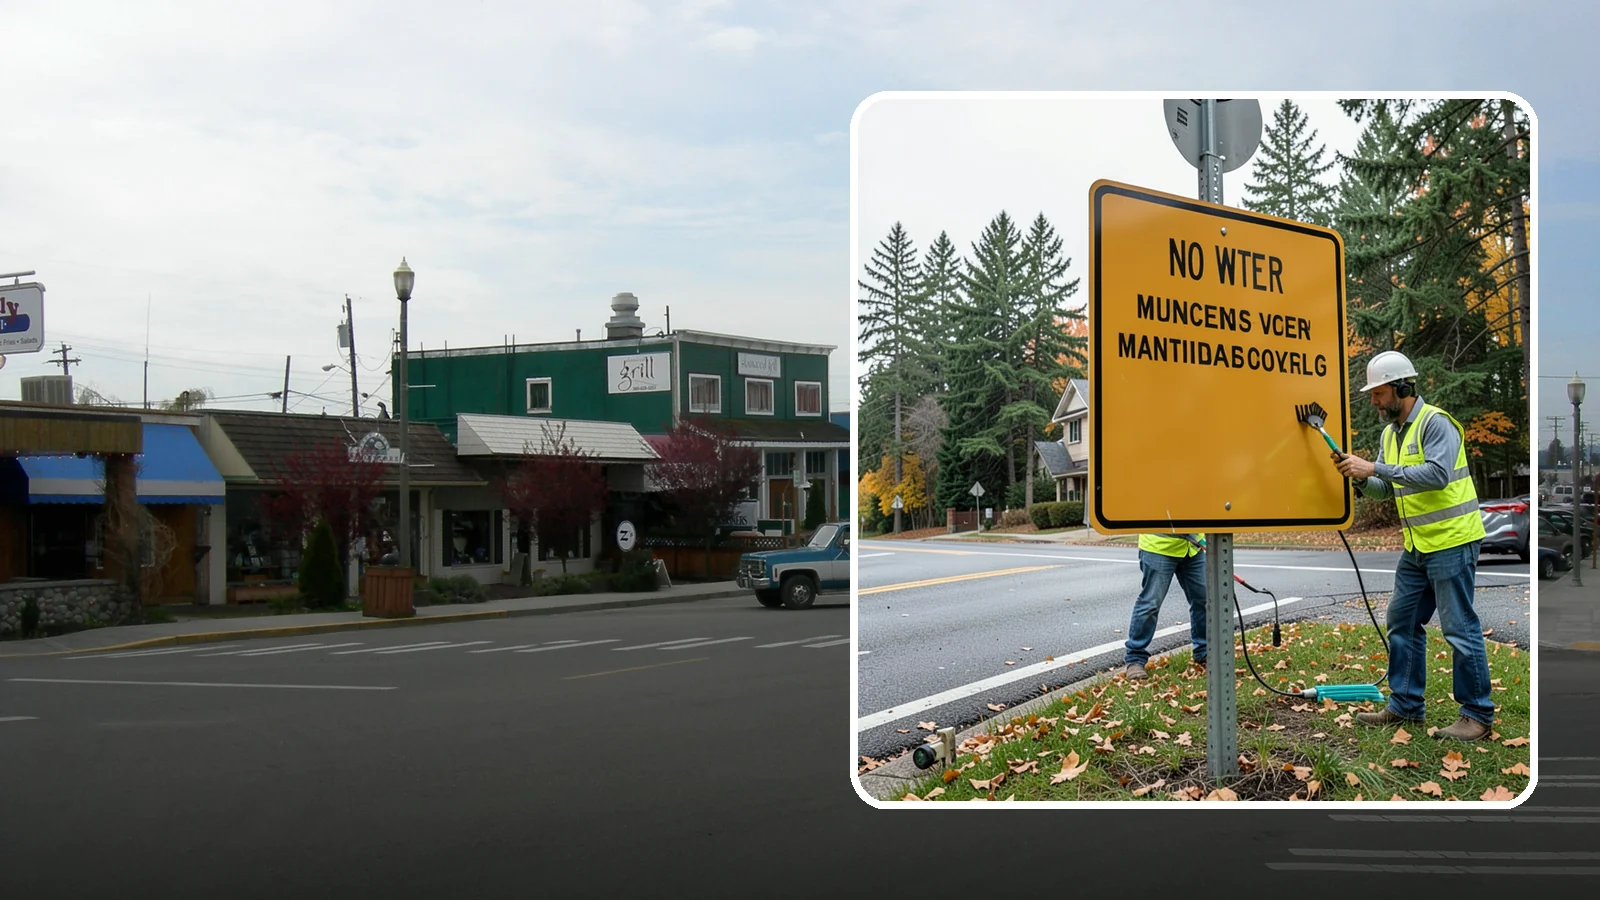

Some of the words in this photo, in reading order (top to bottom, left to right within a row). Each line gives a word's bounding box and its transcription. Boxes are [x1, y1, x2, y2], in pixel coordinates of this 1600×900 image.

[1169, 237, 1204, 281] NO
[1215, 244, 1284, 295] WTER
[1137, 293, 1252, 333] MUNCENS
[617, 355, 655, 392] grill
